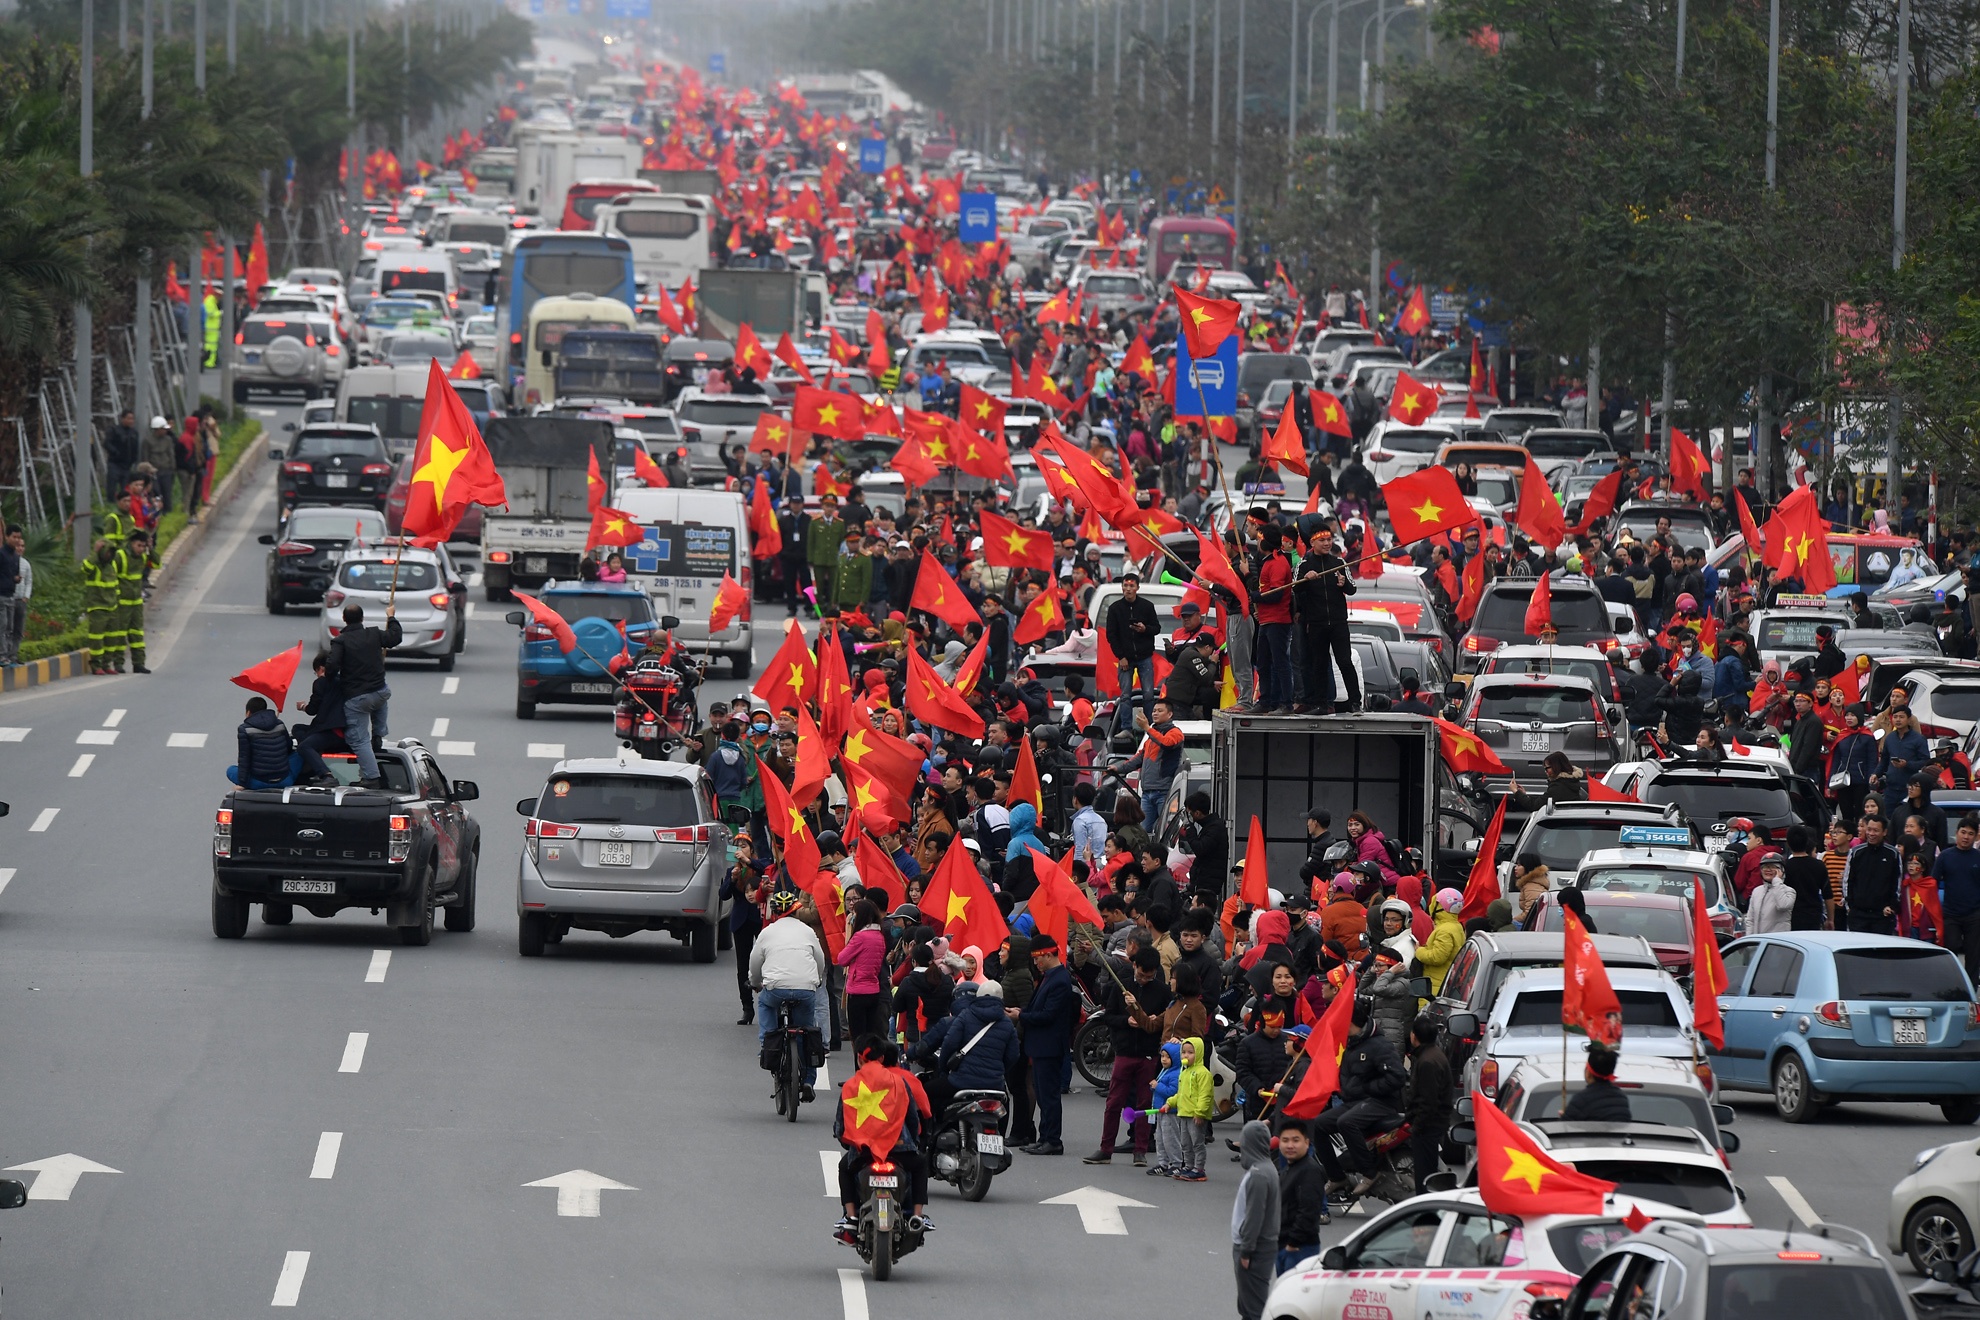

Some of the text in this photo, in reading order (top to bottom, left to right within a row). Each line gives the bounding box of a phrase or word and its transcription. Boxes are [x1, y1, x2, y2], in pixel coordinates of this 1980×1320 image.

[1529, 733, 1543, 742] 30A
[1523, 742, 1549, 751] 557.58
[238, 846, 381, 859] RANGER
[607, 843, 625, 854] 99A
[600, 854, 631, 864] 205.38
[284, 881, 334, 893] 29C-375.31
[1901, 1020, 1918, 1031] 30E
[1895, 1032, 1926, 1043] 256.00
[980, 1143, 1003, 1154] 175.86
[1369, 1291, 1387, 1304] TAXI
